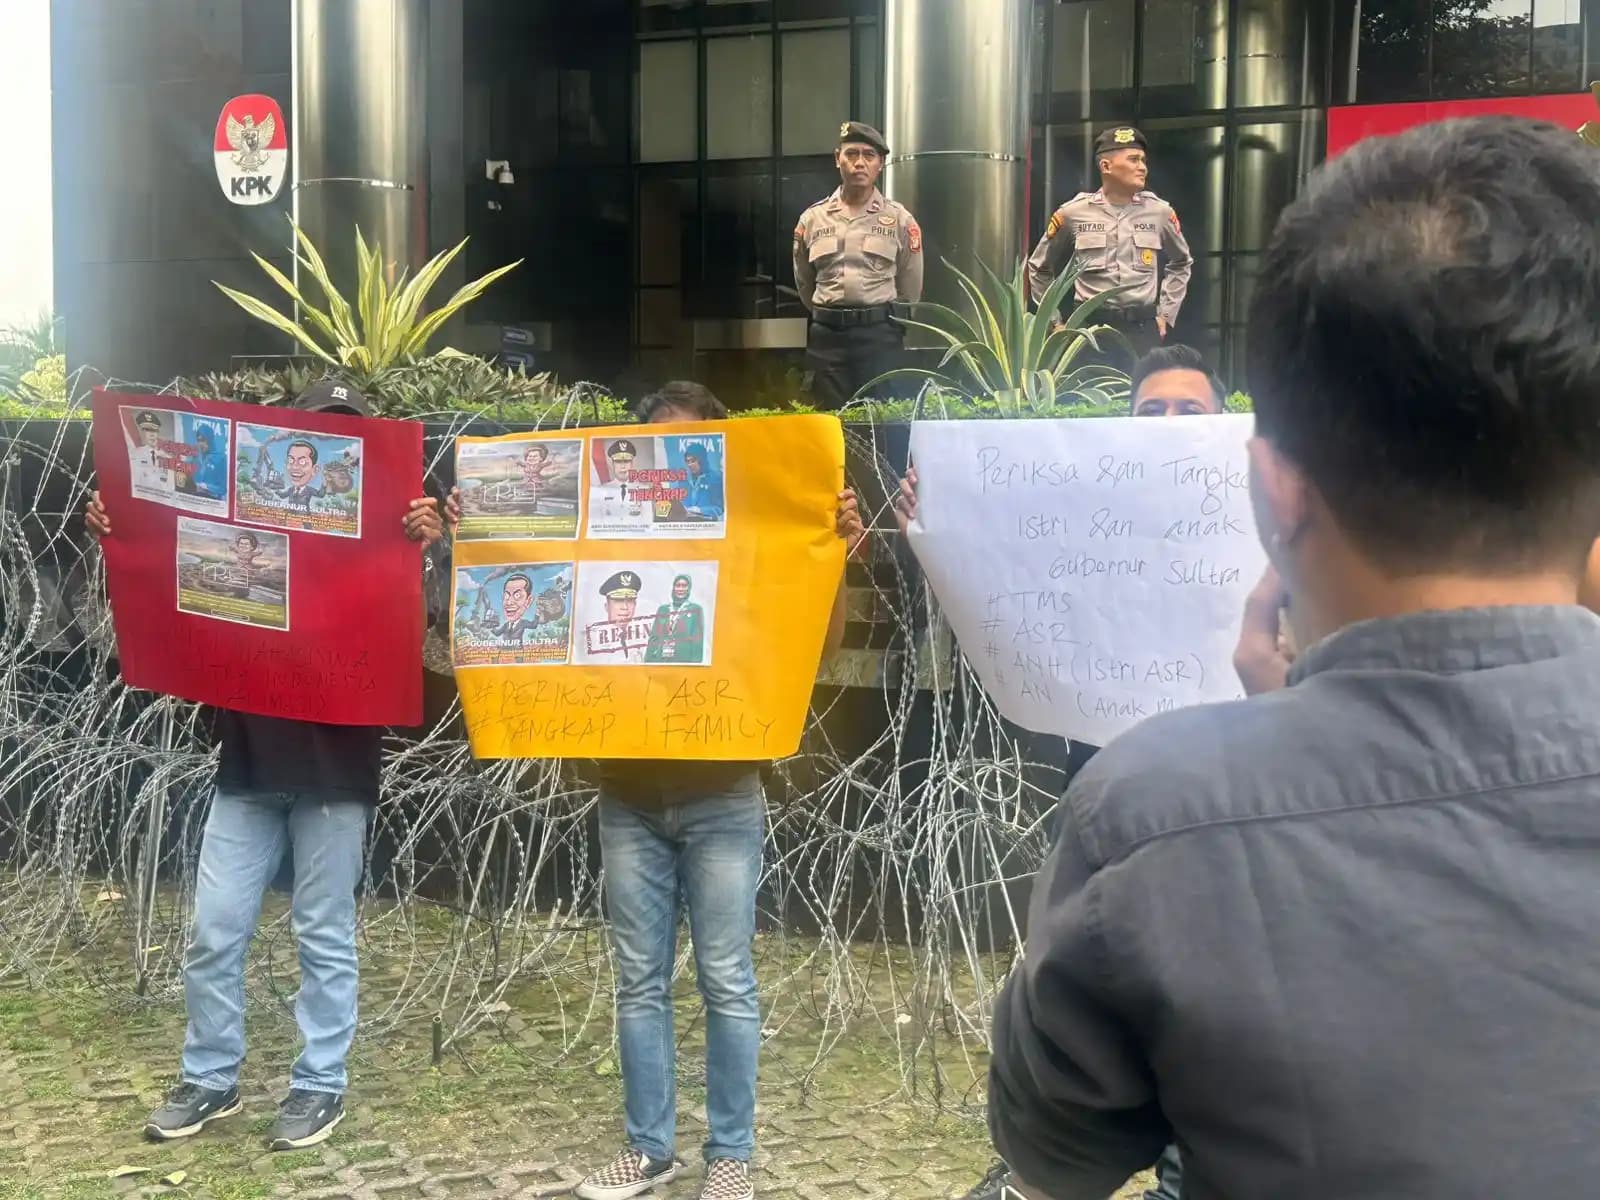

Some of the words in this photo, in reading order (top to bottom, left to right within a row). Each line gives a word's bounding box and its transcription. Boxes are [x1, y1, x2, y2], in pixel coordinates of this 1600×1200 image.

[231, 176, 273, 196] KPK
[871, 225, 897, 239] POLRI
[1133, 223, 1156, 232] POLRI
[977, 446, 1079, 494] Periksa
[1163, 559, 1241, 586] Sultra
[667, 677, 744, 708] ASR
[659, 712, 779, 750] FAMILY
